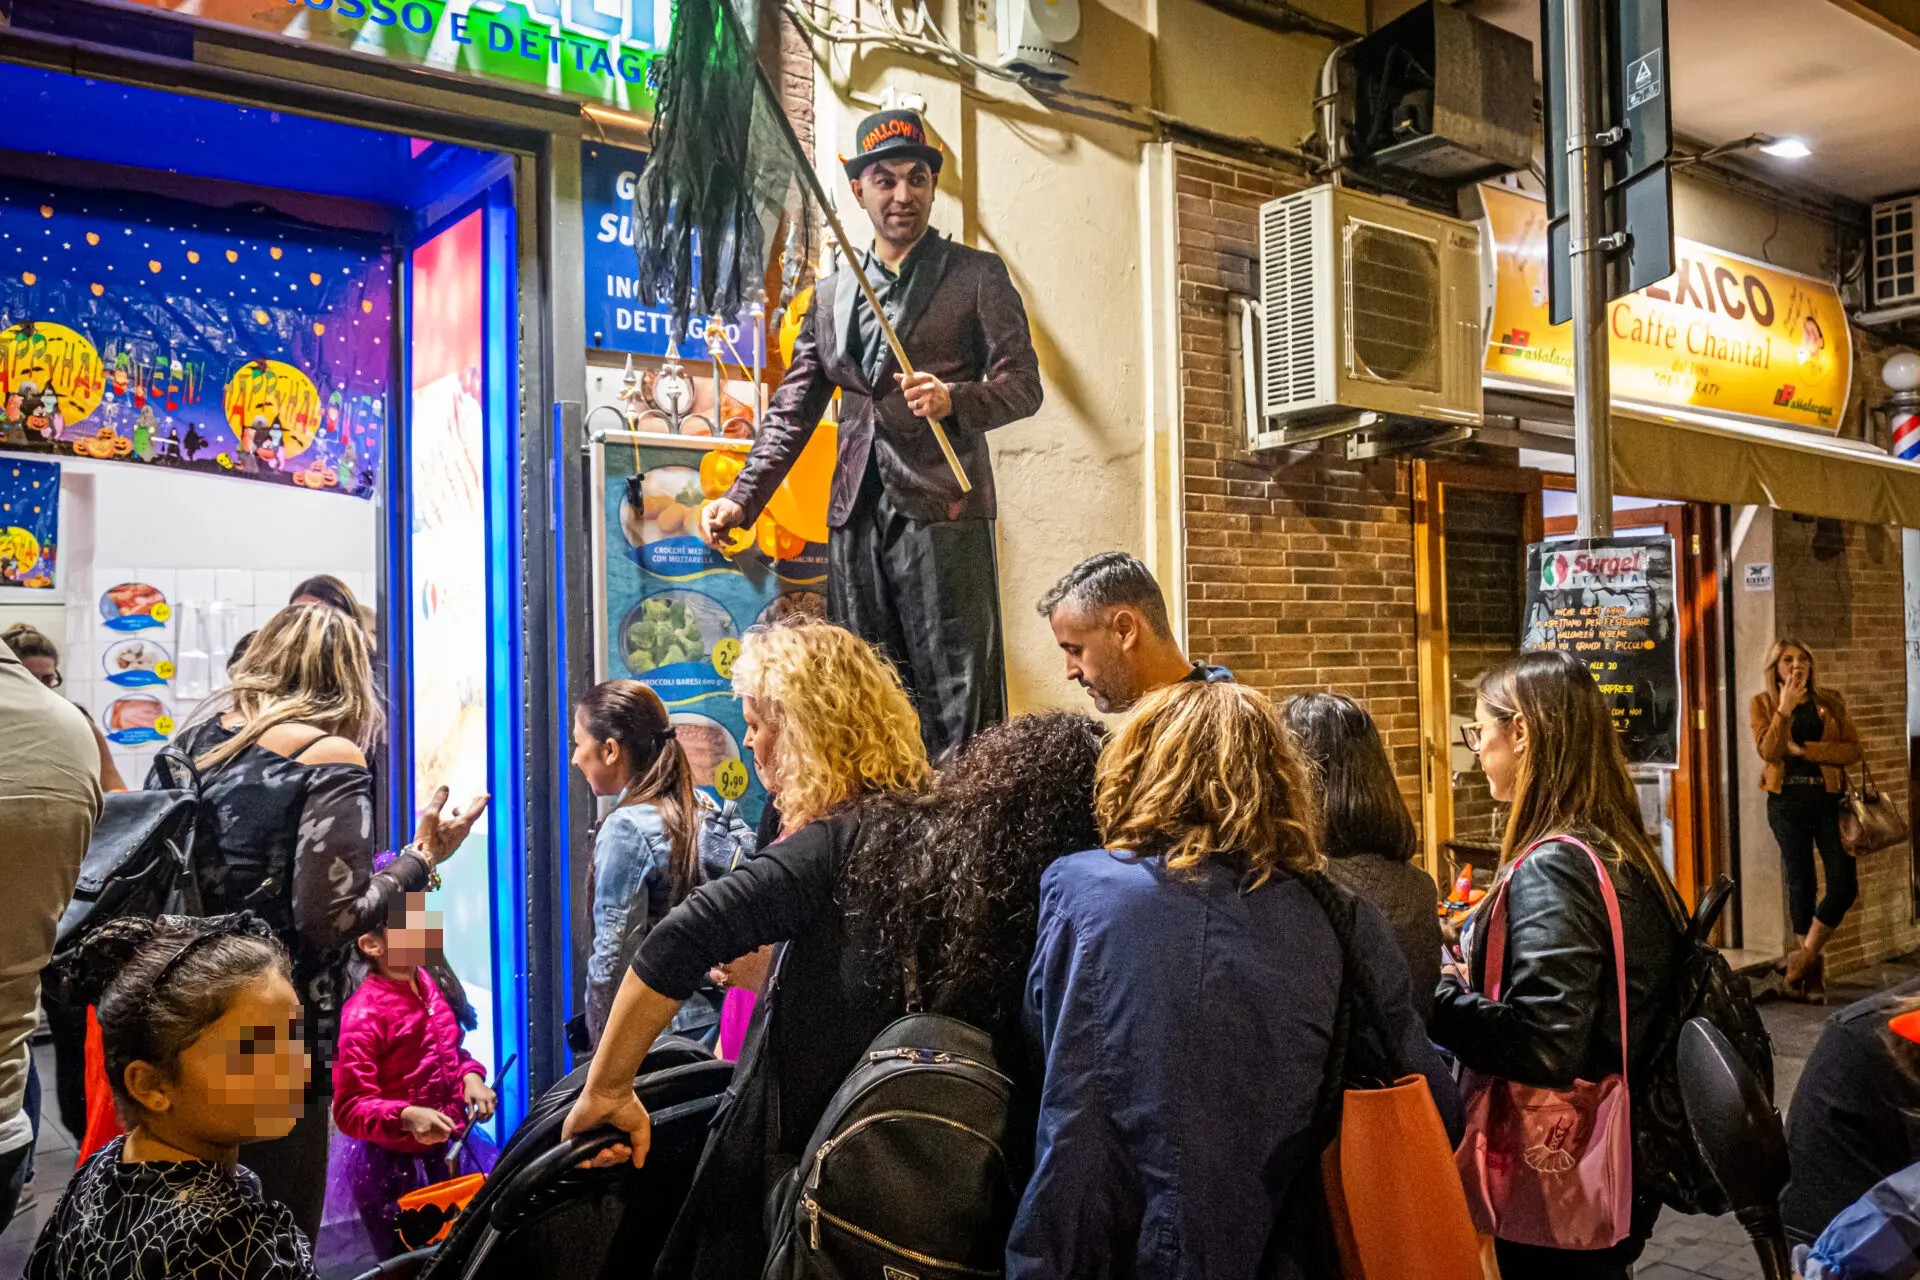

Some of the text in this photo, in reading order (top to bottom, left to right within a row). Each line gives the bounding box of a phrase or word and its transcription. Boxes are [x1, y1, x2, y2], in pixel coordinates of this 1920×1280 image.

[450, 12, 472, 44] E
[488, 21, 658, 88] DETTAG
[1635, 256, 1774, 328] XICO
[1572, 550, 1642, 577] Surgel
[1571, 573, 1641, 585] ITALIA
[1605, 606, 1626, 615] ANNO
[1543, 619, 1582, 629] ASPETTIAMO
[1584, 618, 1602, 628] PER
[1556, 630, 1628, 639] HALLOWEEN INSIEME
[1575, 641, 1601, 651] GRANDI
[1604, 642, 1611, 650] E
[1590, 661, 1605, 670] ALLE
[1607, 661, 1617, 670] 20
[675, 678, 700, 686] BARESI
[1597, 684, 1634, 695] ORPRESE
